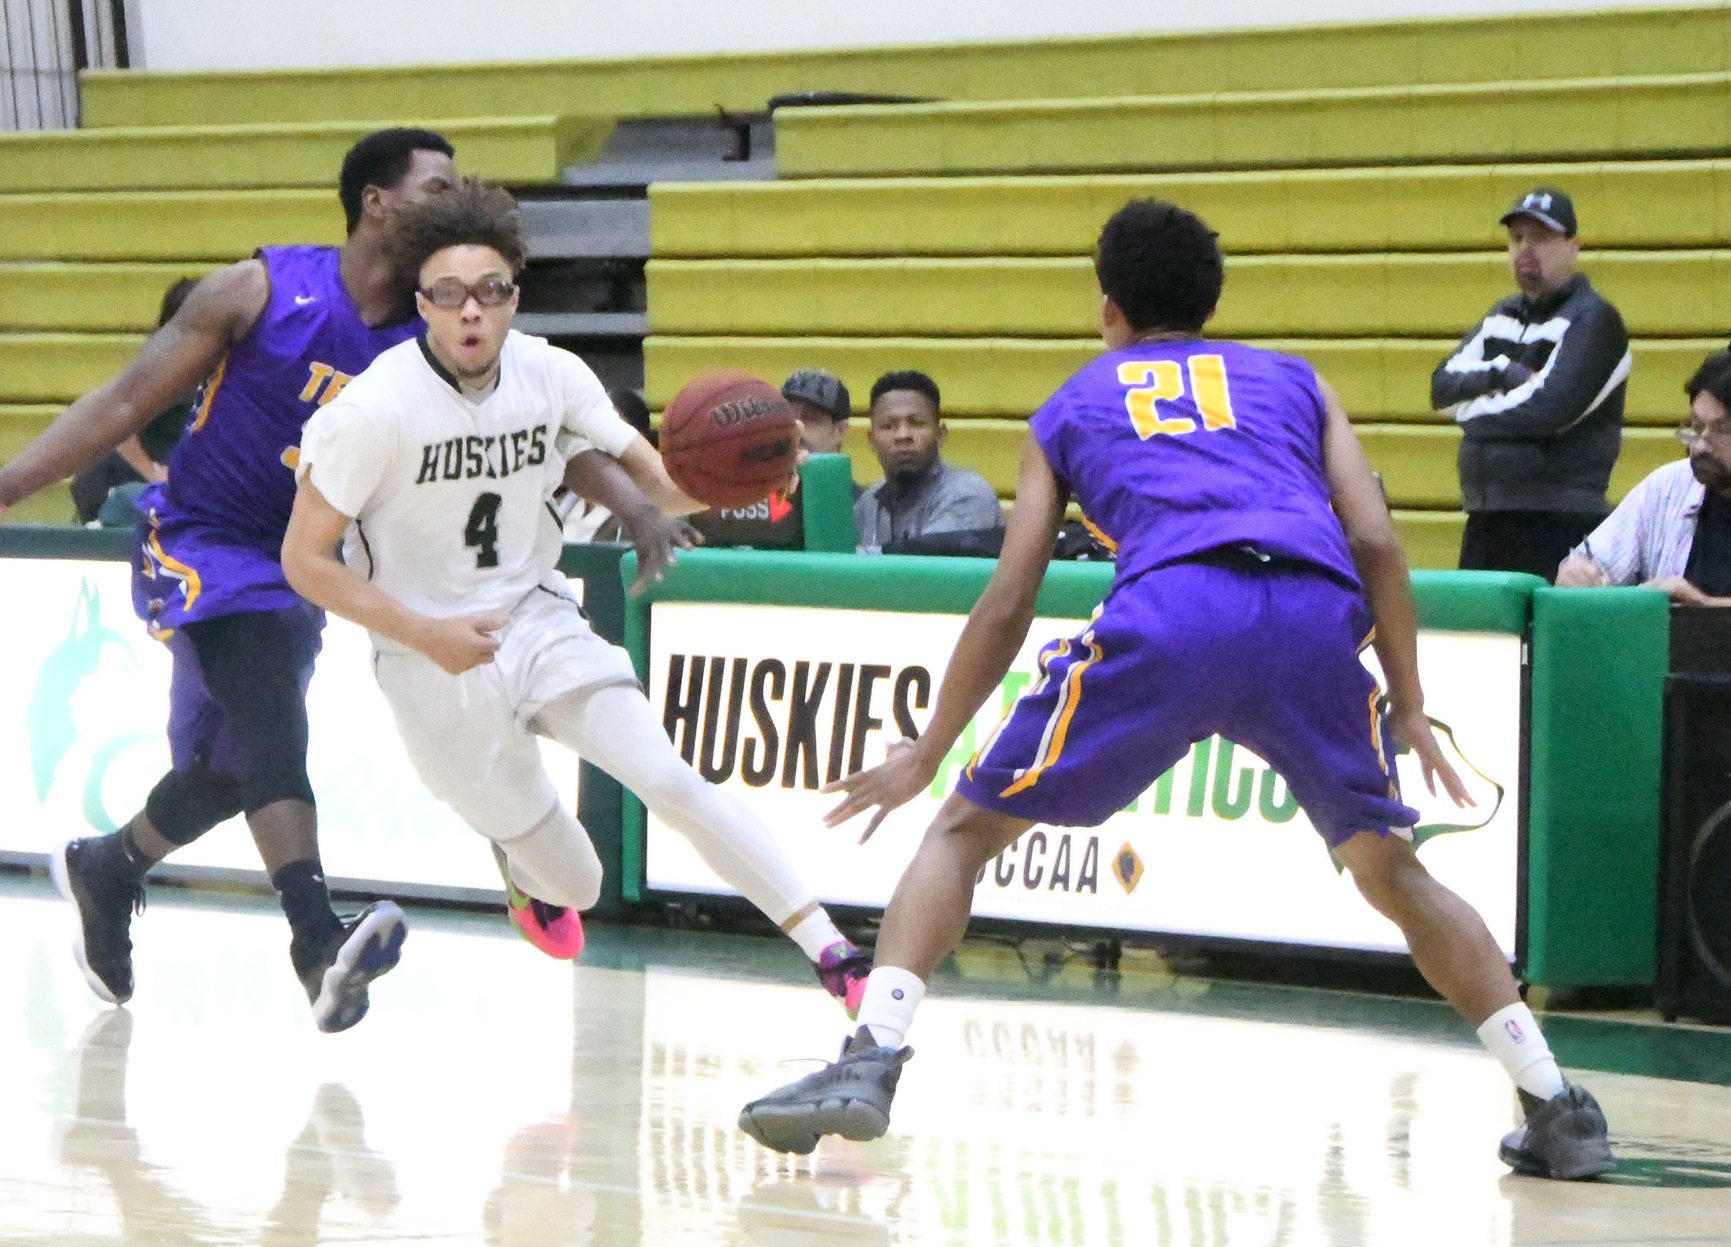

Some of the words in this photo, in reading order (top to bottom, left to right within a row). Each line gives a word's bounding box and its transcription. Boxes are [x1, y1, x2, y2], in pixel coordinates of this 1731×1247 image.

[707, 396, 790, 427] Wil
[1117, 354, 1236, 441] 21
[415, 425, 547, 484] HUSKIES
[464, 492, 502, 568] 4
[663, 654, 931, 790] HUSKIES
[976, 831, 1099, 894] CCAA
